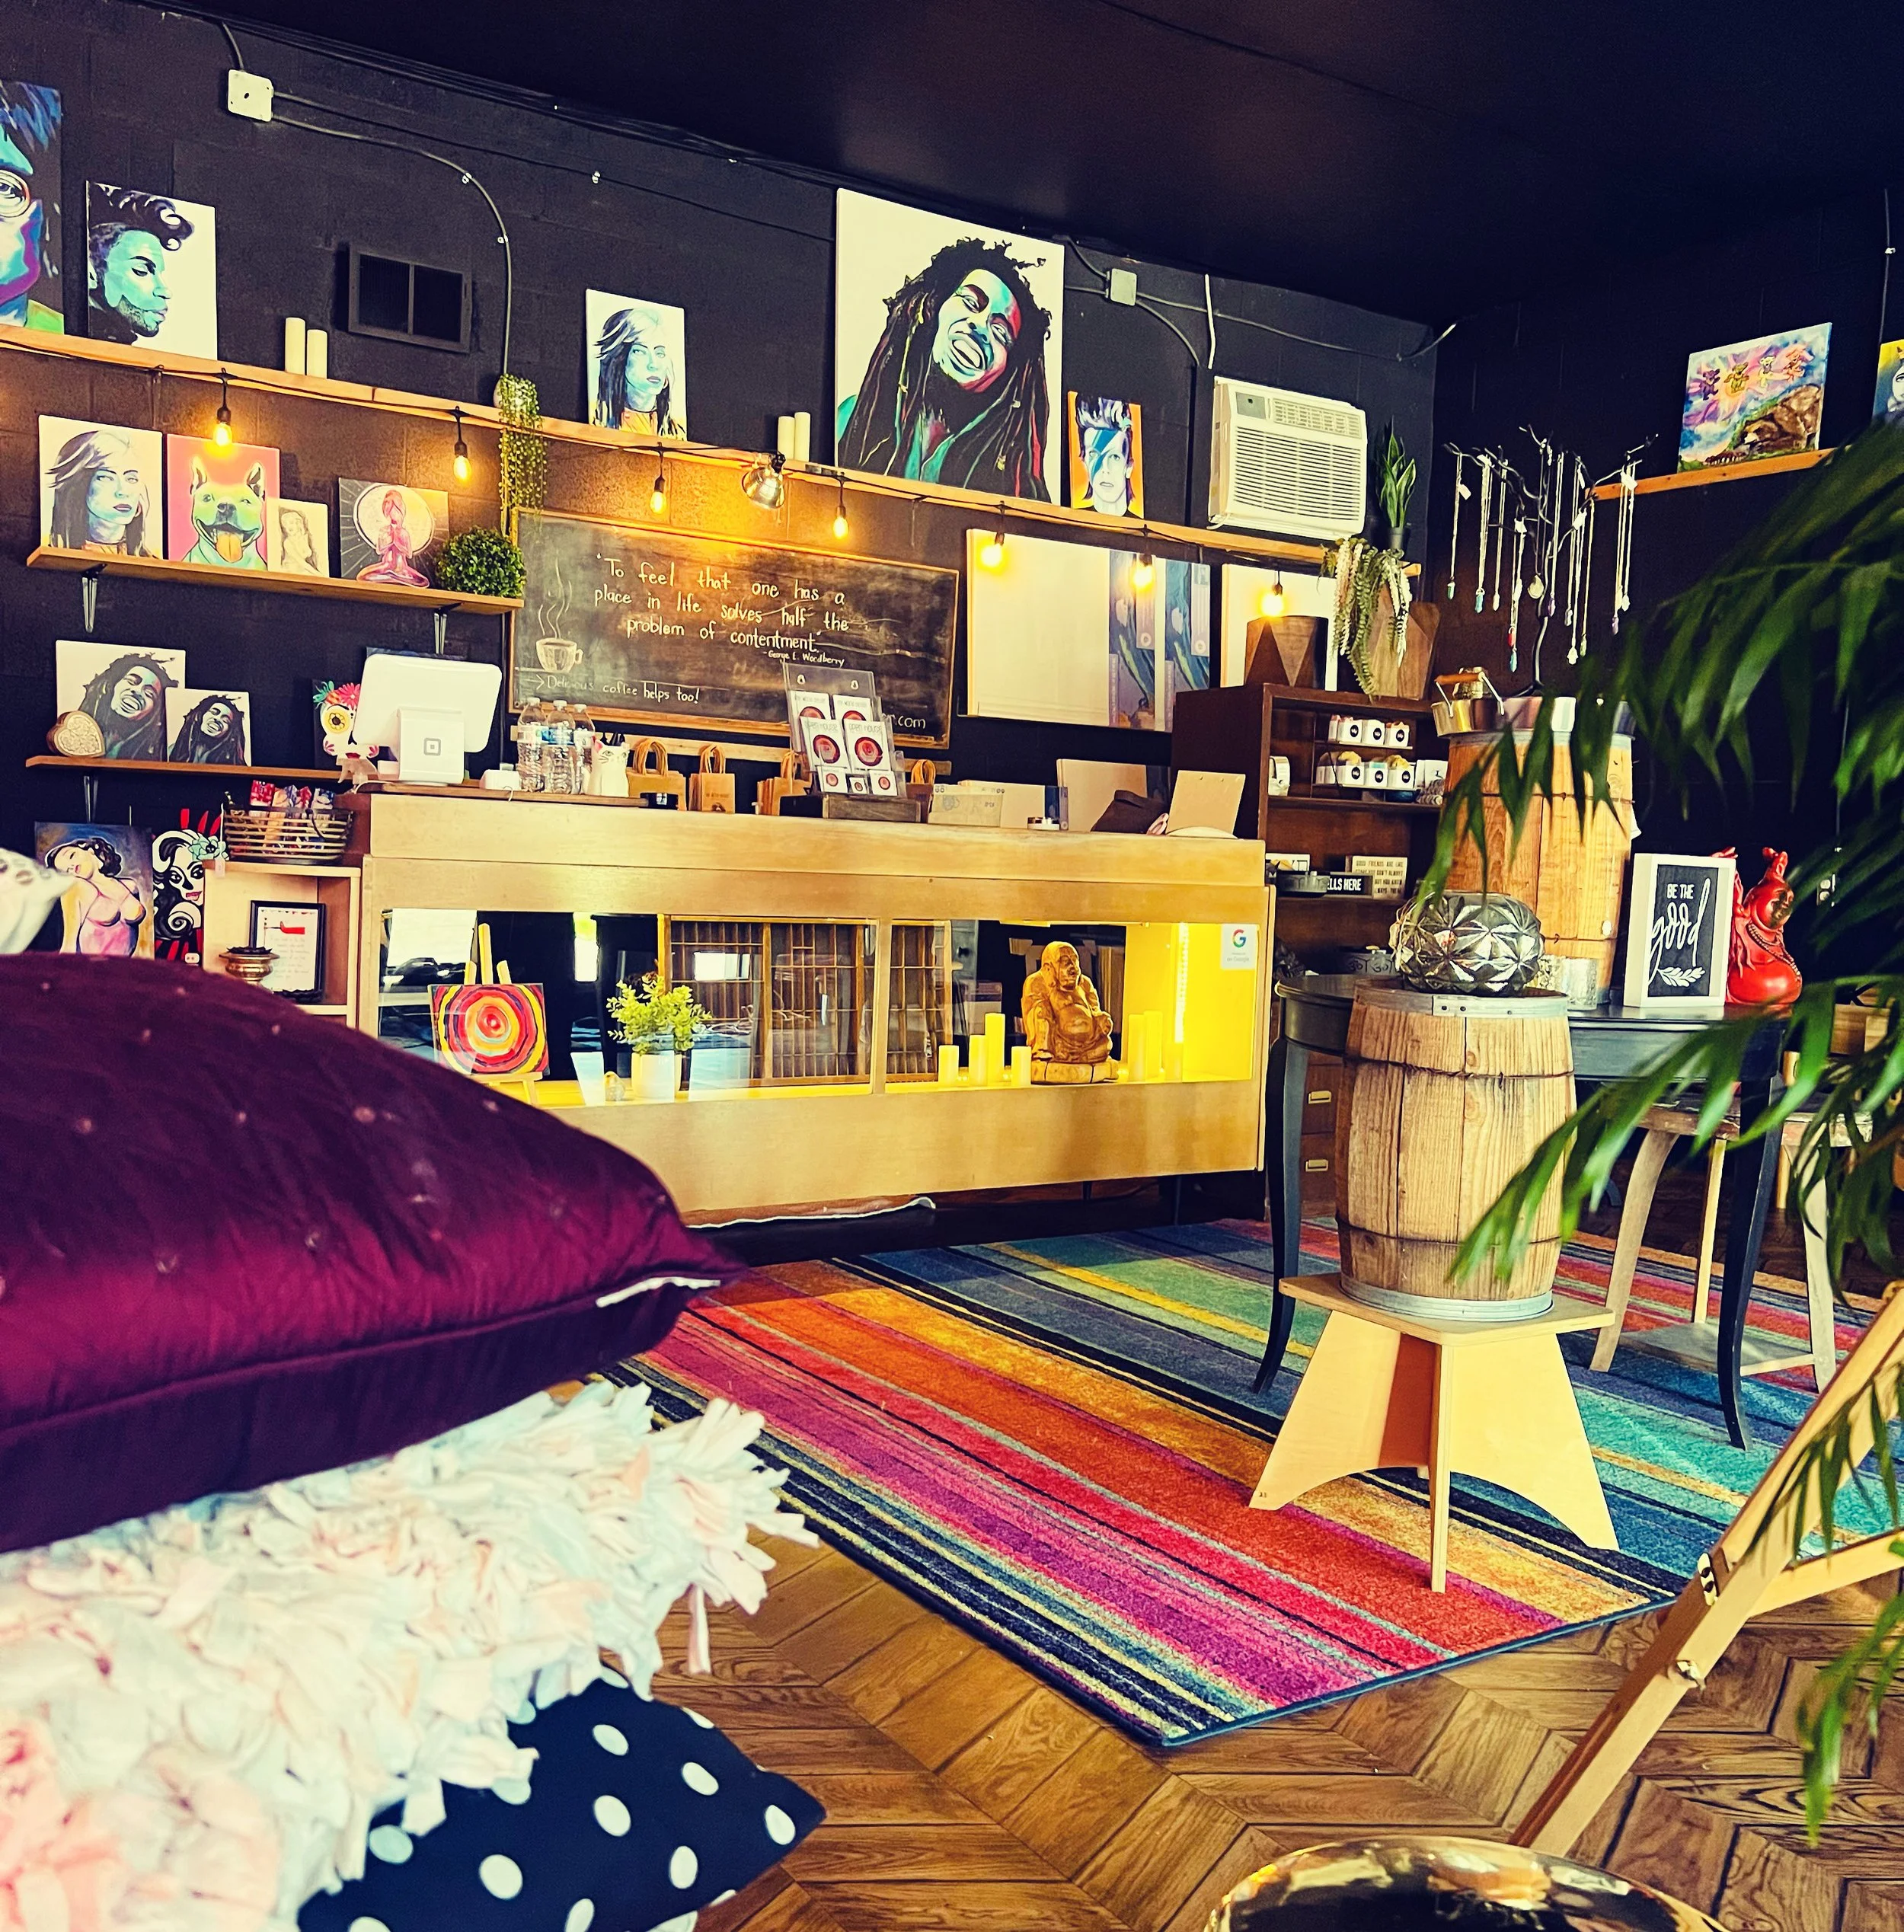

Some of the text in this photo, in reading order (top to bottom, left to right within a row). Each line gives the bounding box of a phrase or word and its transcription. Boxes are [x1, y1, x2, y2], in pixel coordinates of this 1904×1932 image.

[638, 561, 674, 586] feel
[698, 567, 731, 590] that
[752, 583, 779, 598] one
[794, 579, 819, 601] has
[835, 592, 845, 605] a
[595, 584, 849, 631] place in life solves half the
[627, 616, 685, 638] problem
[700, 621, 717, 639] of
[547, 675, 699, 704] Delious coffee helps too!
[1343, 878, 1362, 891] HERE
[1666, 883, 1695, 899] BE THE
[1648, 878, 1711, 985] good
